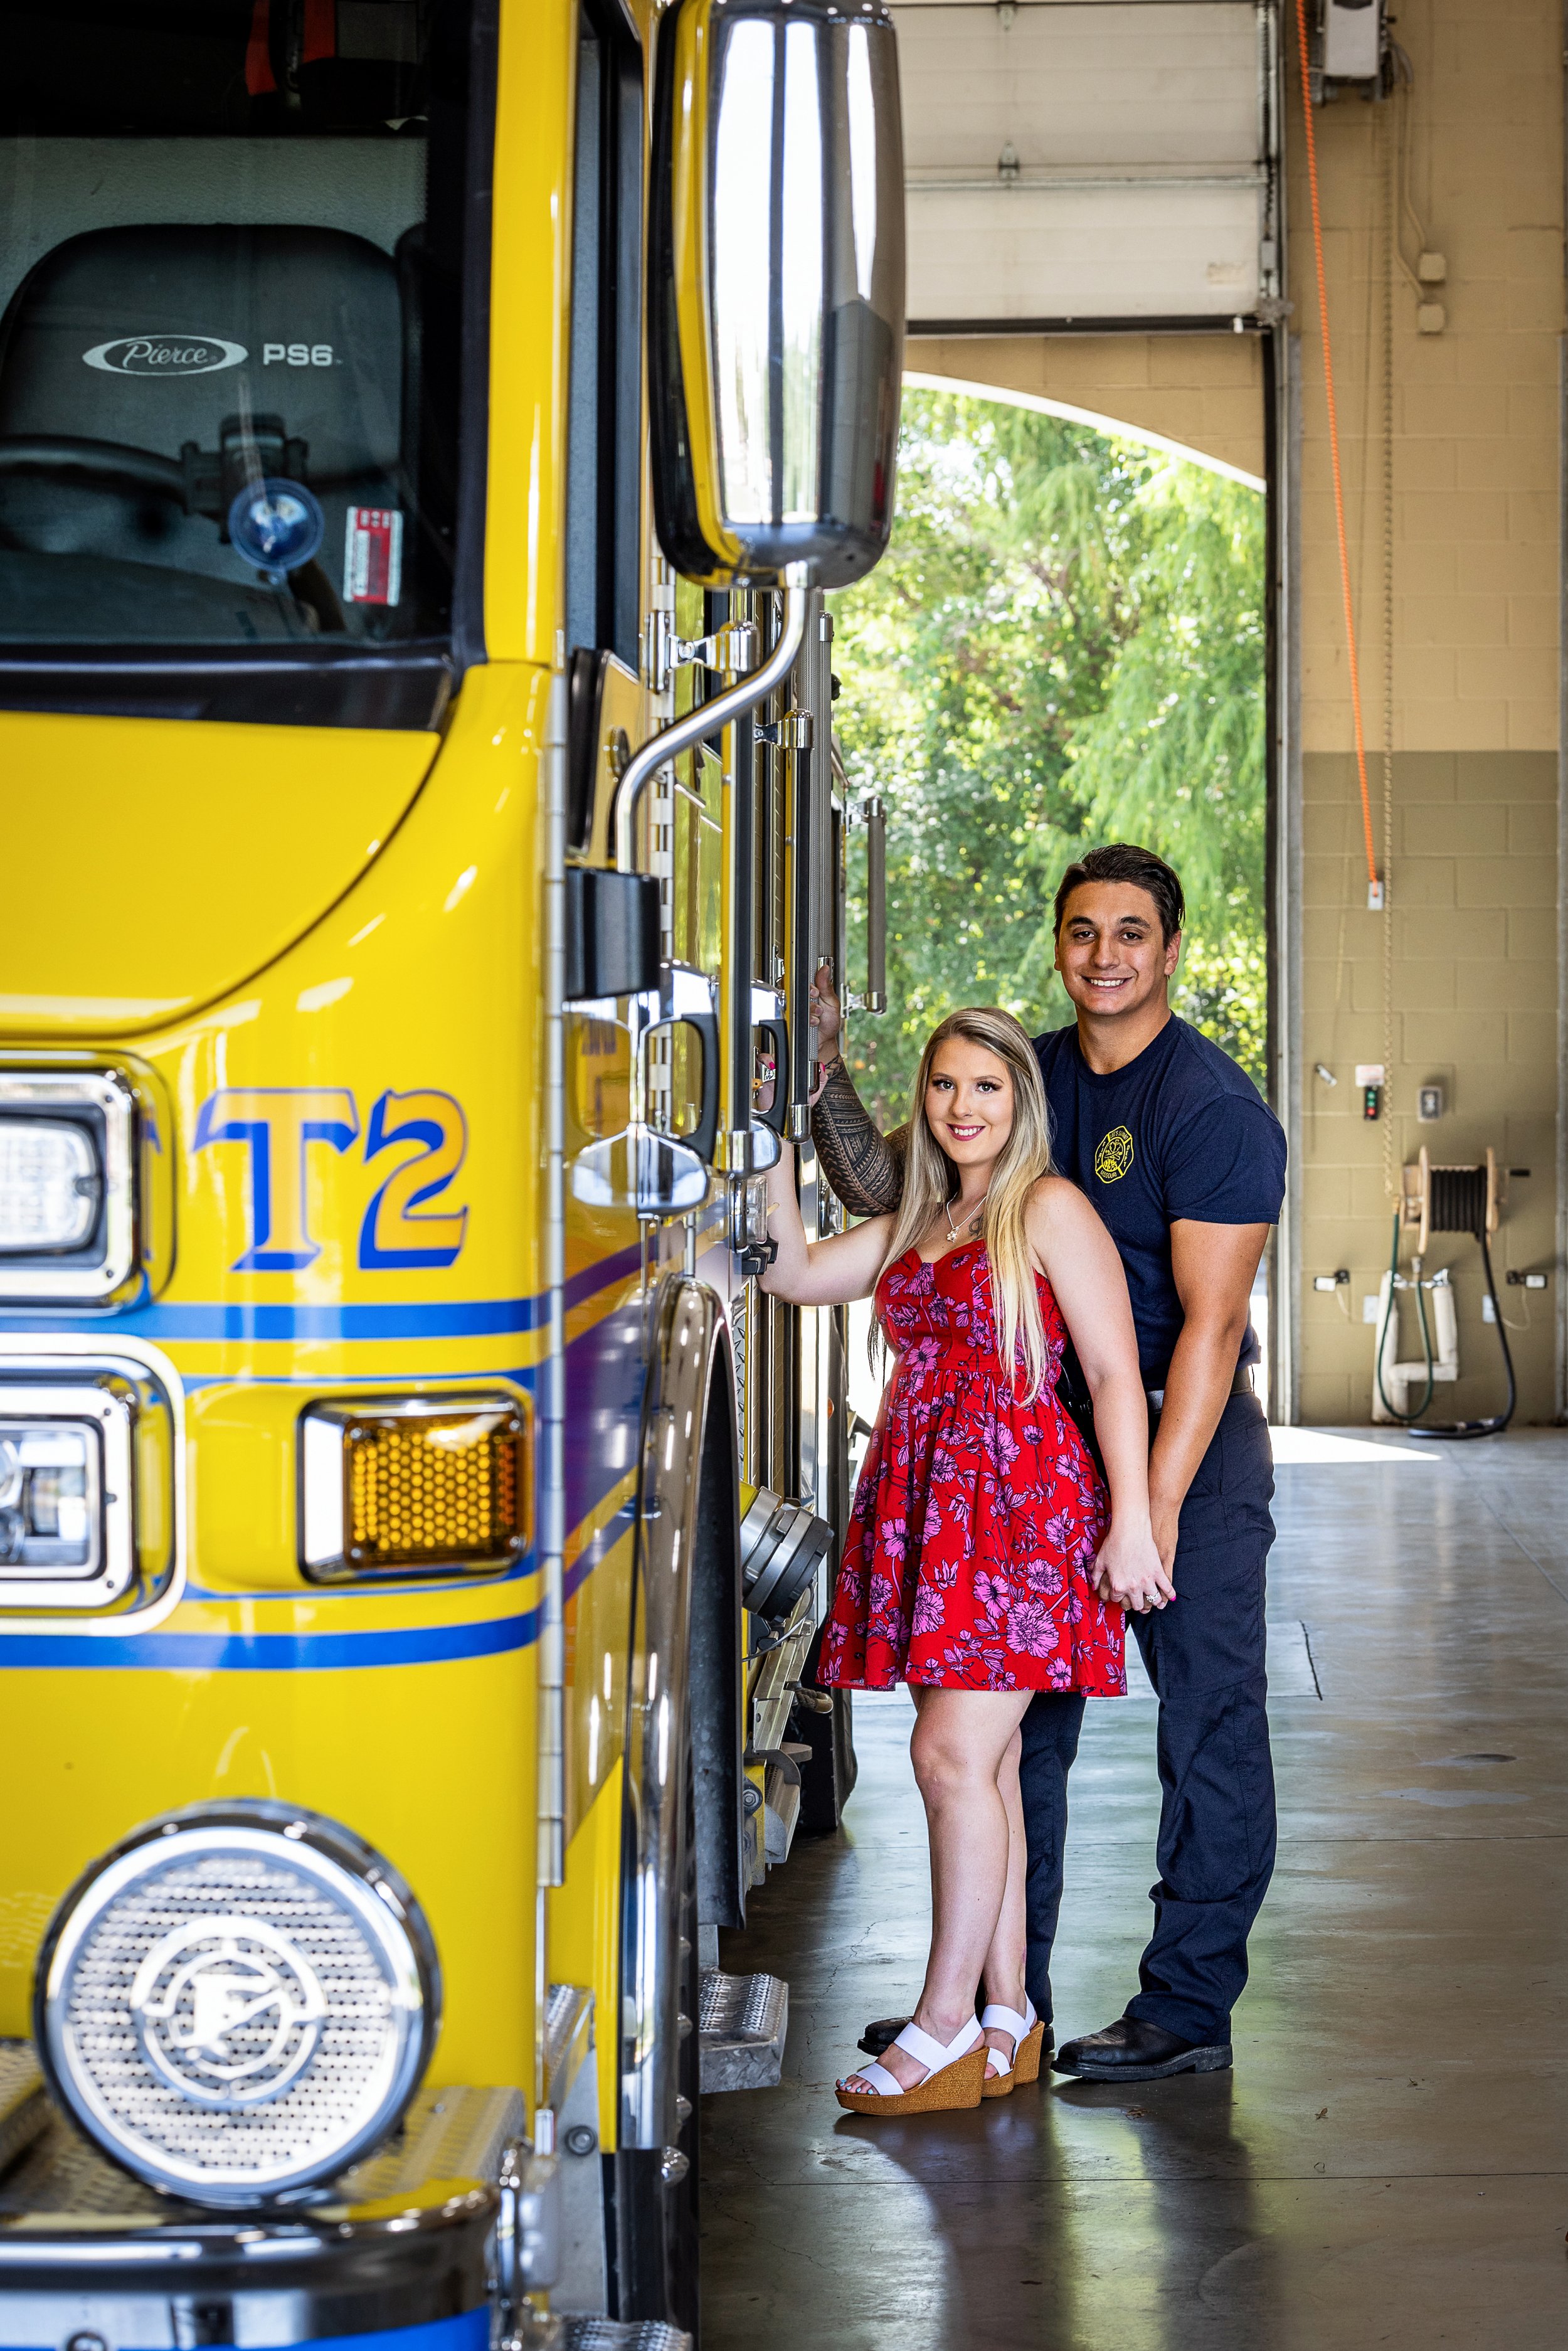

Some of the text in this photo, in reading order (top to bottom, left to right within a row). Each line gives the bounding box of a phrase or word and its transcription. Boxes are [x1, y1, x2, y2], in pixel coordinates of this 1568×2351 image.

[122, 340, 334, 368] Pierce PS6
[1097, 1142, 1106, 1164] FIRE
[190, 1087, 469, 1273] T2
